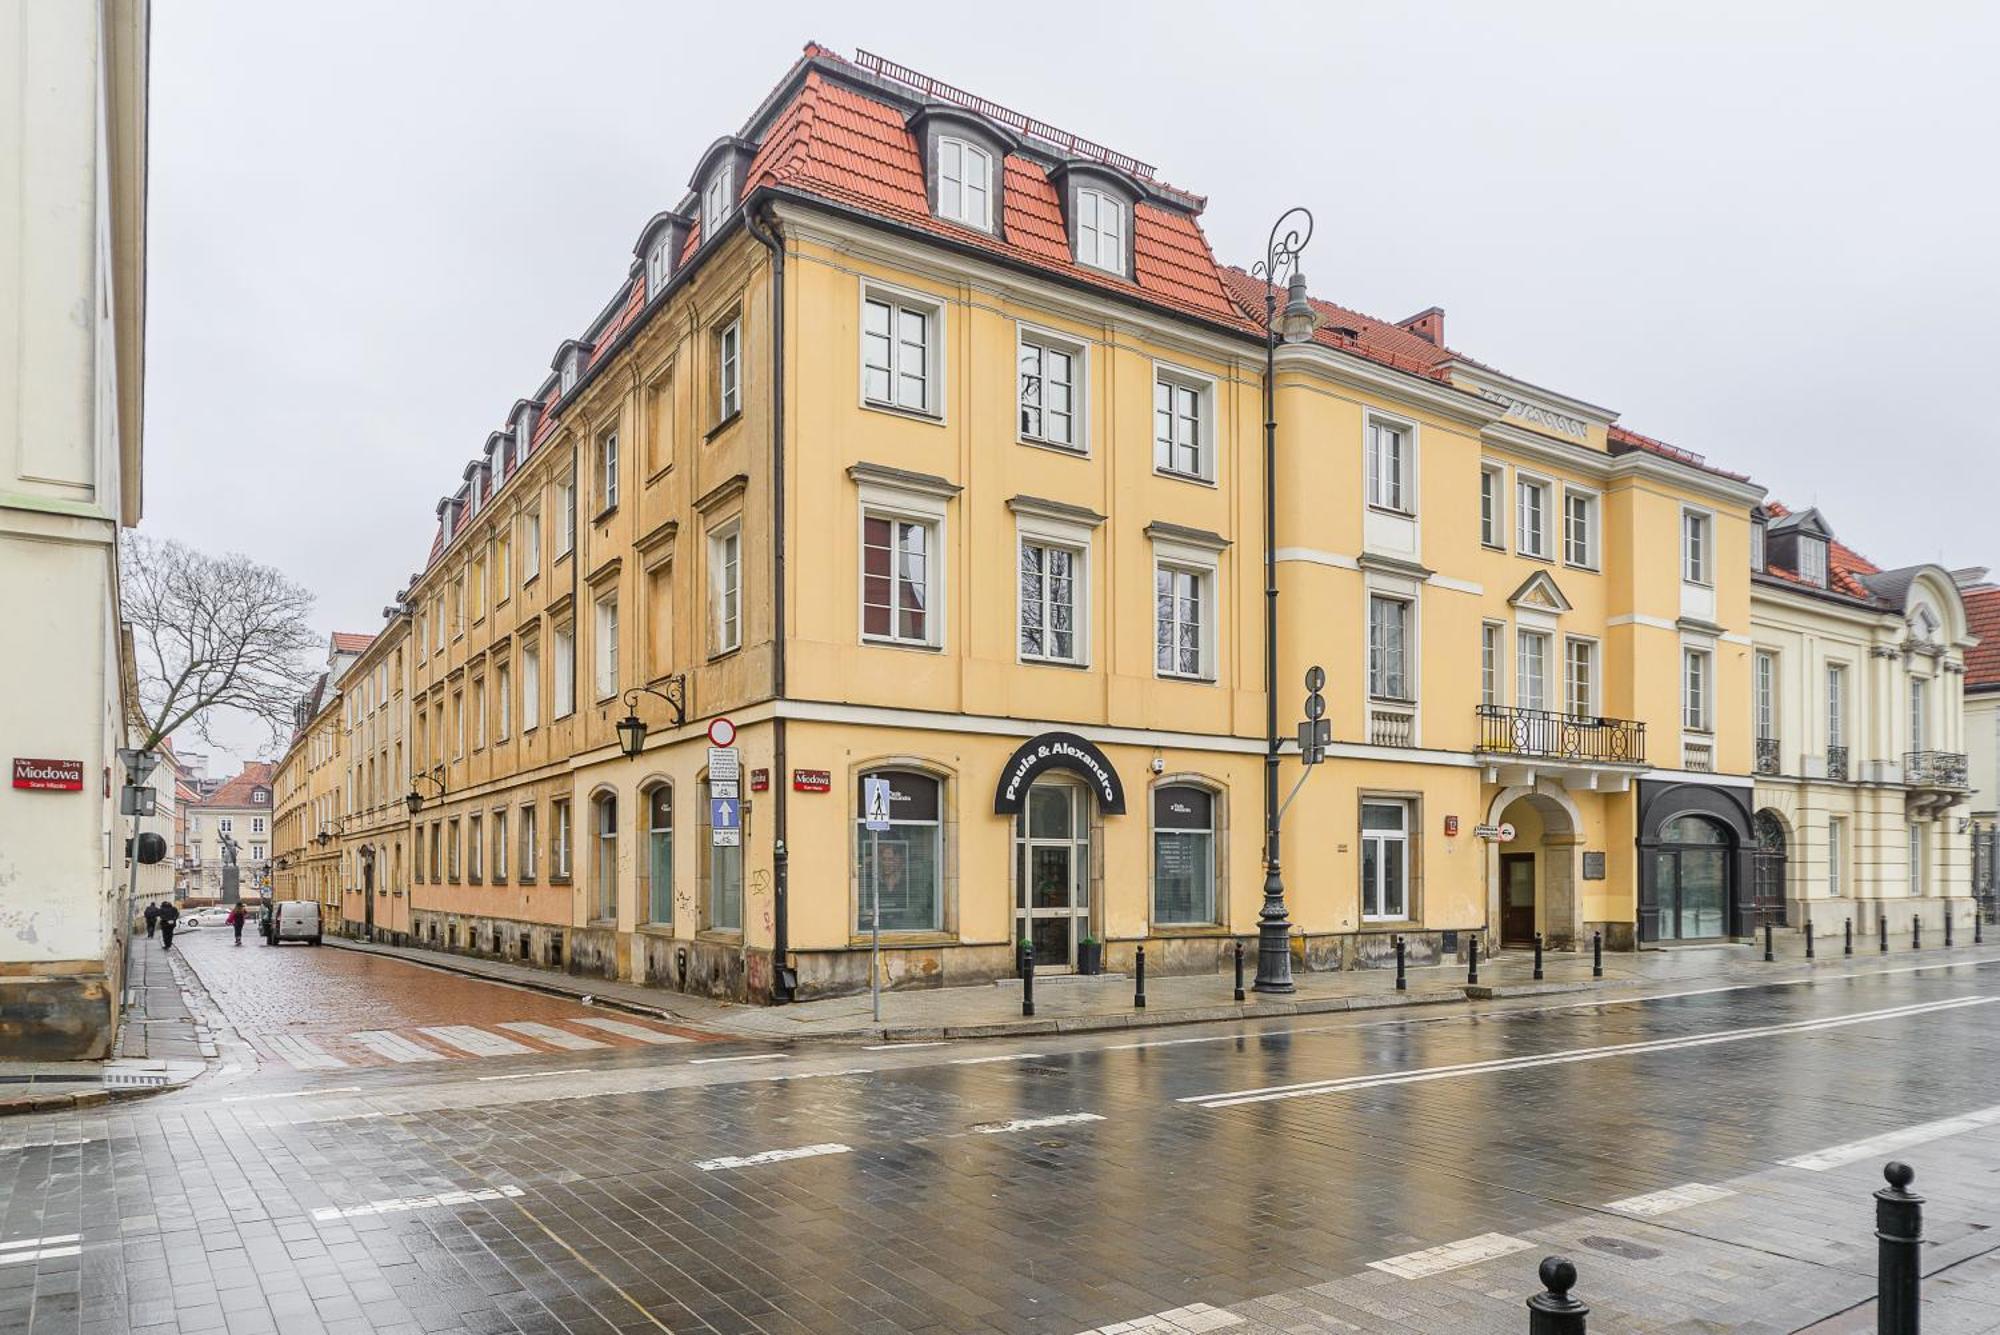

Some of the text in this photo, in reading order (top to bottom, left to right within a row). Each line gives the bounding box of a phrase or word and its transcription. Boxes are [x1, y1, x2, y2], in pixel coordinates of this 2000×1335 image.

[16, 766, 79, 780] Miodowa
[1006, 742, 1113, 802] Paula & Alexandro
[796, 774, 829, 785] Miodowa
